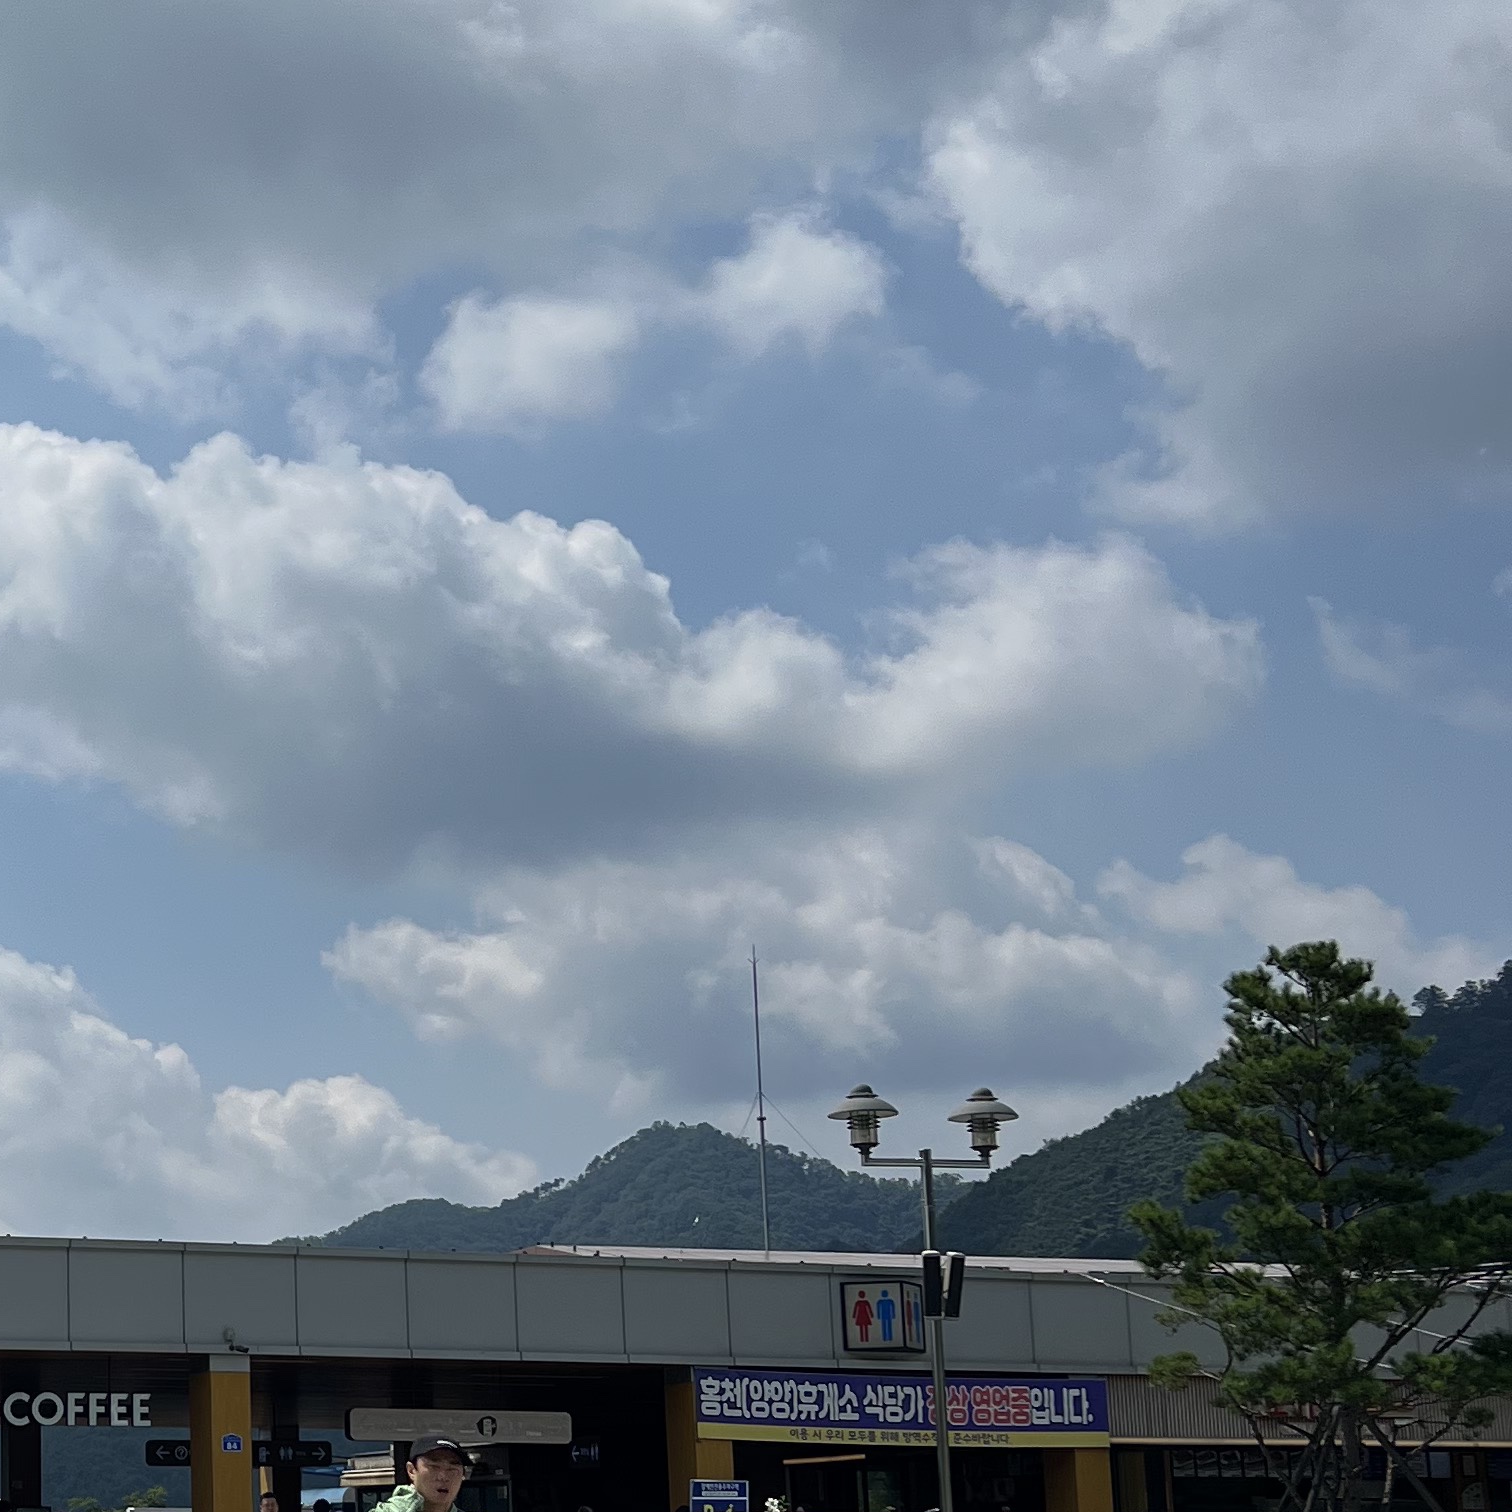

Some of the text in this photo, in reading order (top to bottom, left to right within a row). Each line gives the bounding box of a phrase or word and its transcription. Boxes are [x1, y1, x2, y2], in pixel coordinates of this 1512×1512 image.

[3, 1391, 152, 1427] COFFEE
[699, 1376, 860, 1422] 홍천(양양)휴게소
[862, 1383, 925, 1425] 식당가
[825, 1429, 844, 1441] 우리
